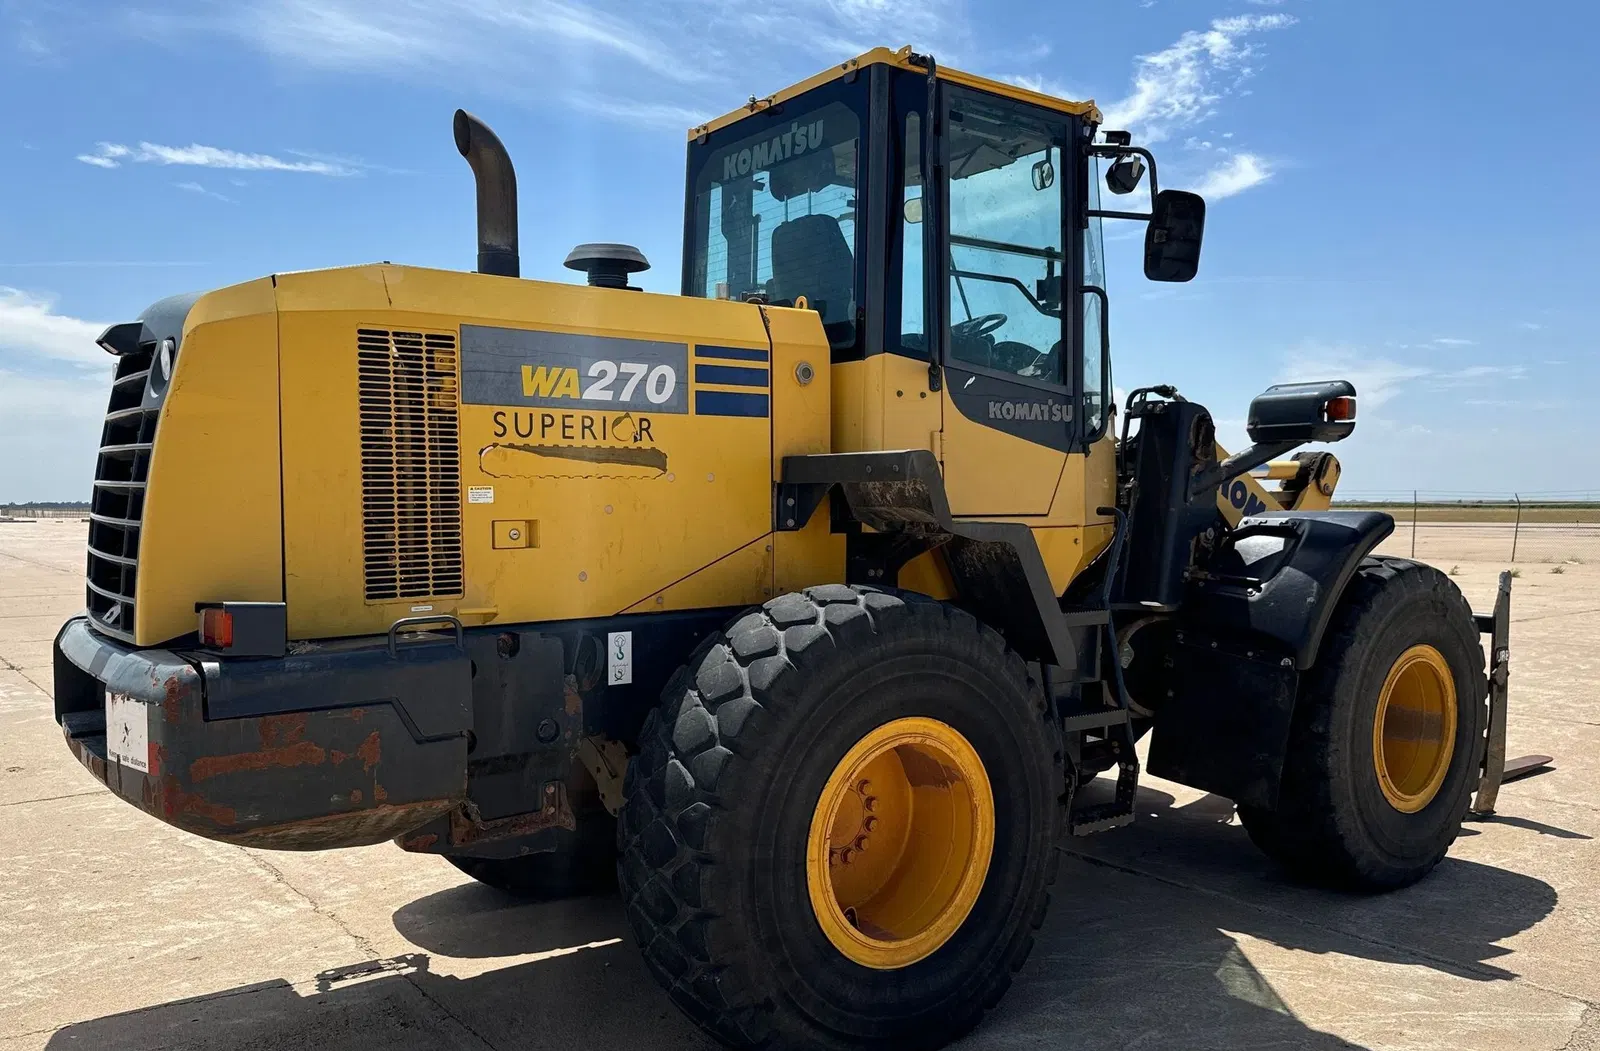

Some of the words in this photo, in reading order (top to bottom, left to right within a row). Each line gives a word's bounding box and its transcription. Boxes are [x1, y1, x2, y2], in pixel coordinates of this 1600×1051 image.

[723, 120, 824, 181] KOMATSU
[493, 411, 655, 443] SUPERIOR
[988, 399, 1074, 422] KOMATSU
[1221, 480, 1267, 516] OM
